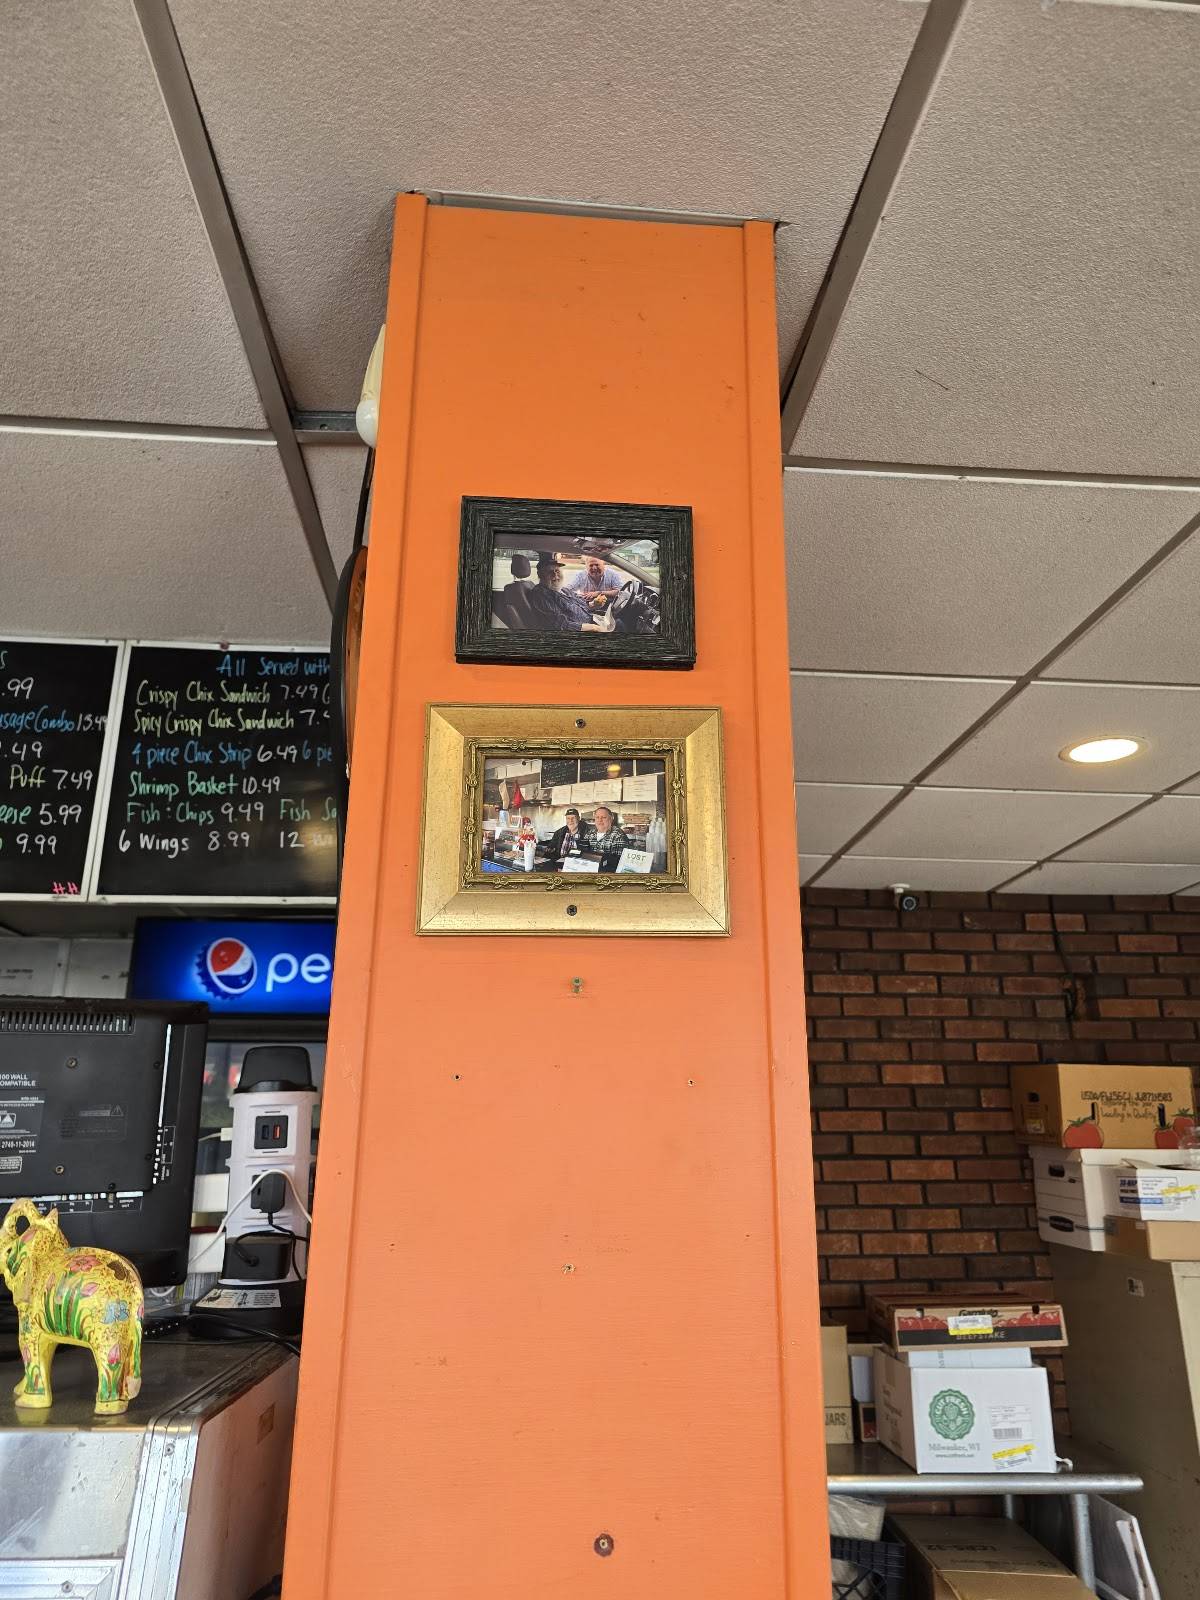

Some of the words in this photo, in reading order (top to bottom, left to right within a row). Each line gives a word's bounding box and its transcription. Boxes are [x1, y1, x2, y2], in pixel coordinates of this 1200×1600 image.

[216, 654, 246, 678] All
[257, 656, 300, 676] Served
[136, 679, 178, 711] Crispy
[186, 680, 215, 702] Chix
[220, 680, 271, 704] Sandwich
[280, 683, 319, 700] 7.49
[133, 708, 162, 738] Spicy
[165, 711, 203, 737] Crispy
[207, 707, 236, 729] Chix
[236, 707, 295, 731] Sandwich
[146, 743, 180, 769] piece
[256, 743, 299, 763] 6.49
[302, 740, 312, 760] 6
[9, 763, 47, 790] Puff
[52, 768, 94, 790] 7.49
[128, 770, 180, 802] Shrimp
[187, 770, 240, 796] Basket
[242, 775, 281, 795] 10.49
[39, 802, 82, 826] 5.99
[126, 801, 161, 825] Fish
[175, 801, 215, 827] Chips
[220, 801, 264, 823] 9.49
[280, 798, 311, 822] Fish
[16, 832, 57, 855] 9.99
[118, 828, 131, 853] 6
[139, 832, 191, 859] Wings
[207, 830, 250, 851] 8.99
[280, 831, 305, 849] 12
[626, 853, 647, 862] LOST
